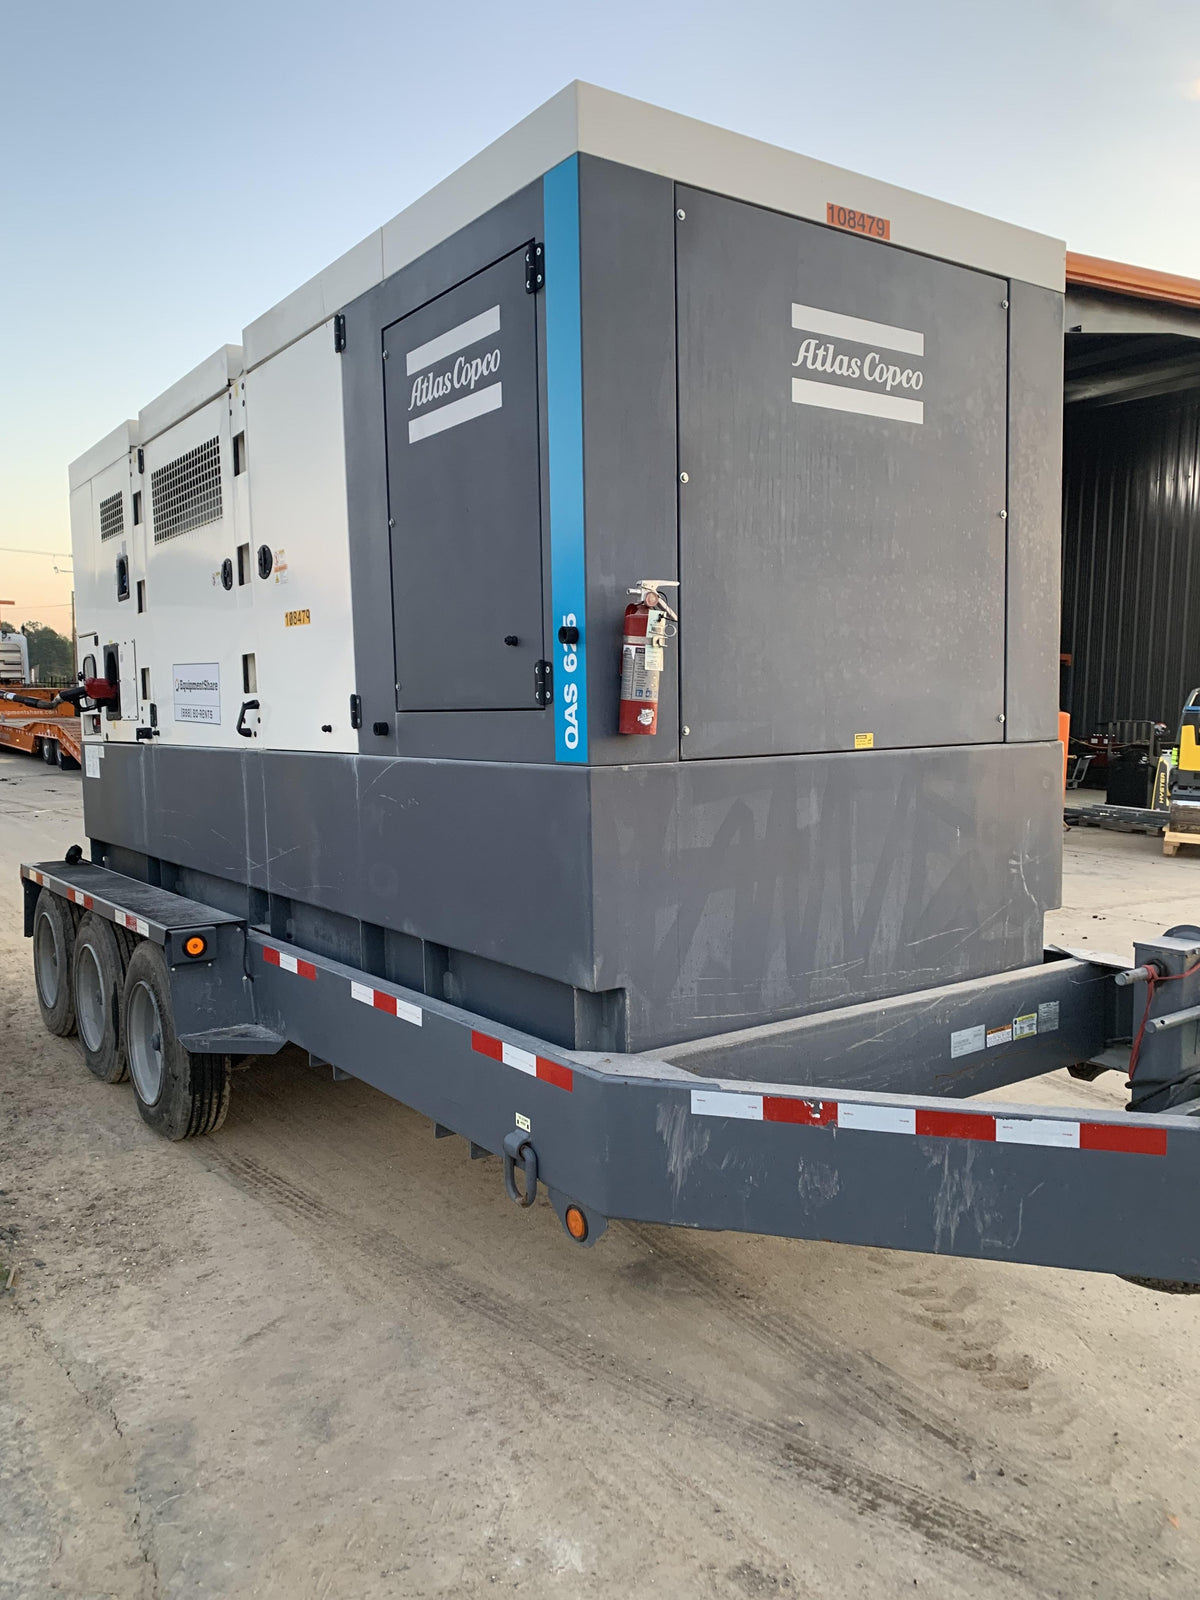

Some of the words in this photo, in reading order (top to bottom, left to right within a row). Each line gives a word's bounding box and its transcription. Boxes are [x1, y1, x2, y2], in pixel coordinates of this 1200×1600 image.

[829, 204, 886, 238] 108479
[407, 371, 452, 411] Atlas
[453, 348, 501, 390] Copco
[791, 338, 861, 379] Atlas
[863, 352, 924, 392] Copco
[285, 609, 311, 626] 108479
[564, 682, 579, 750] QAS
